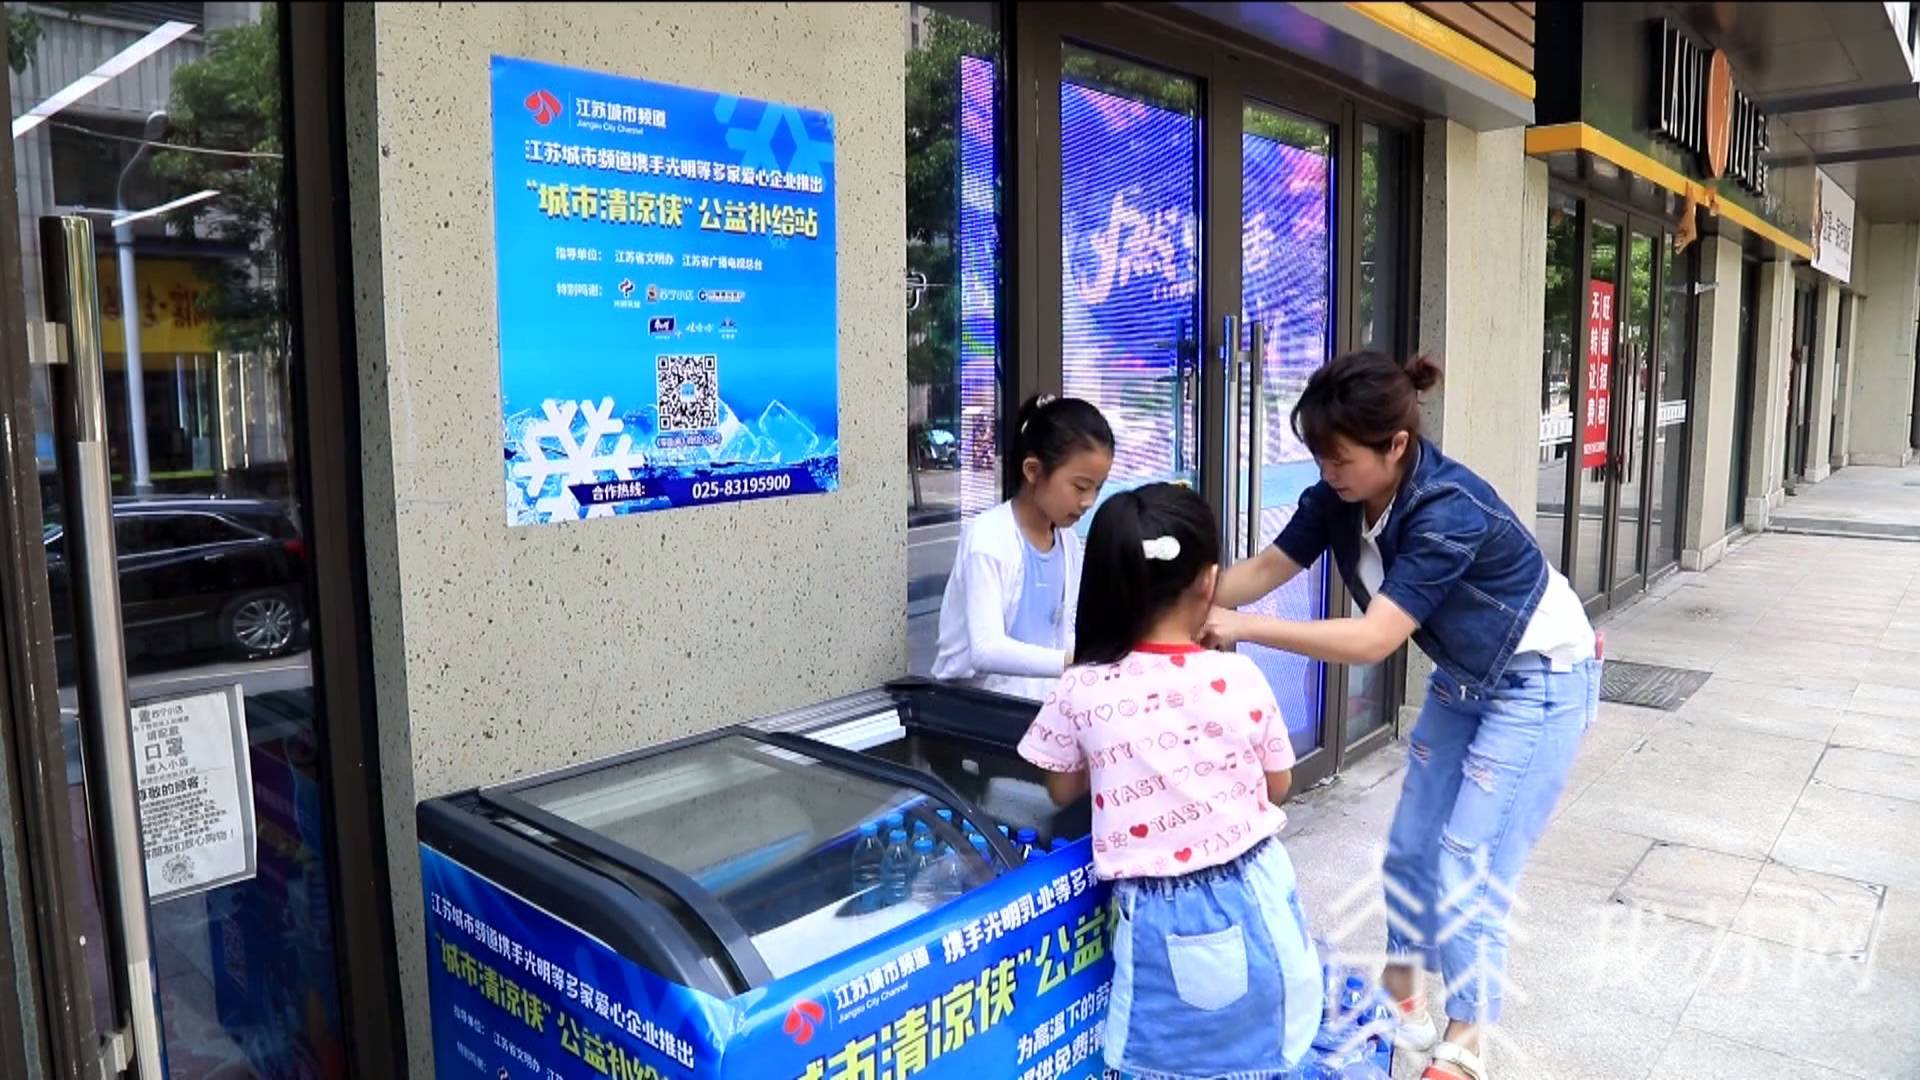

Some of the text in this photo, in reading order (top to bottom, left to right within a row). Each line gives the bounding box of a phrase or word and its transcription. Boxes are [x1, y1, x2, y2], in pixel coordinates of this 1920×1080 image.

[576, 97, 668, 129] 江苏城市频道
[524, 138, 824, 194] 江苏城市频道携手光明等多家爱心企业推出
[692, 473, 791, 500] 025-83195900
[145, 736, 185, 761] 口罩
[431, 891, 695, 1070] 江苏城市频道携手光明等多家爱心企业推出
[832, 945, 931, 1011] 江苏城市频道
